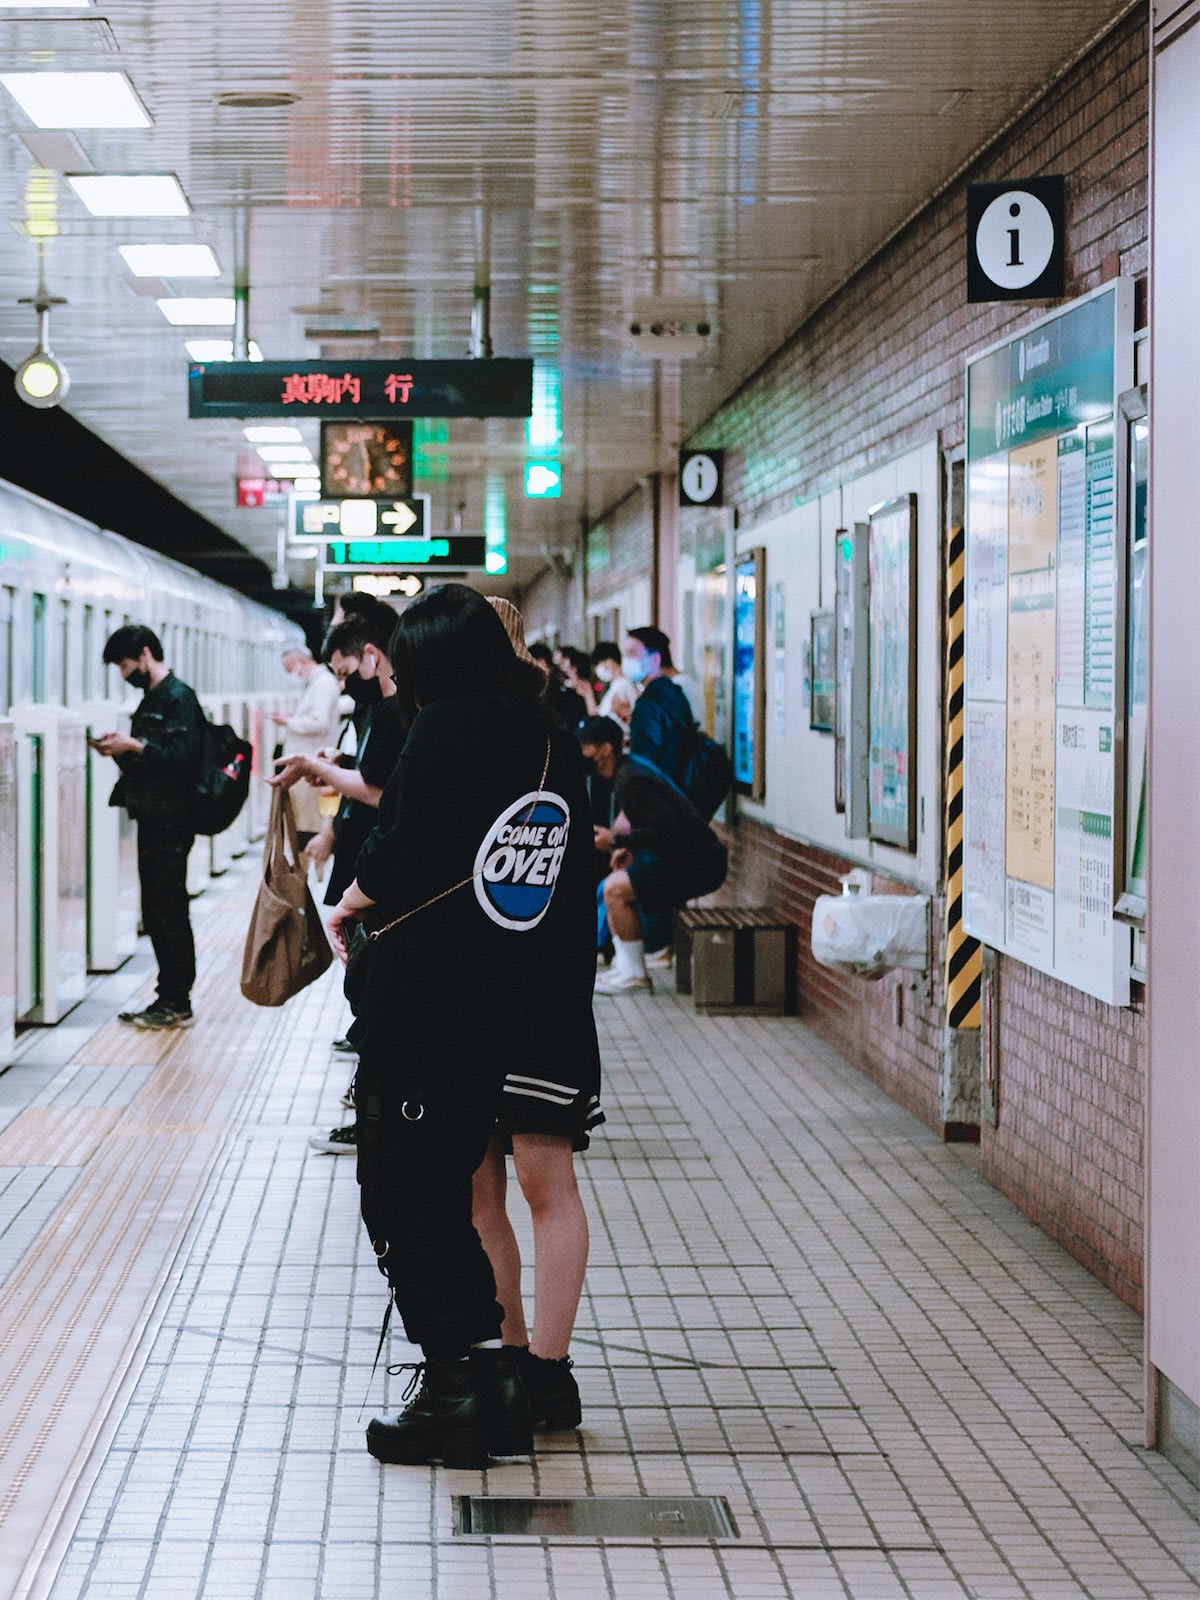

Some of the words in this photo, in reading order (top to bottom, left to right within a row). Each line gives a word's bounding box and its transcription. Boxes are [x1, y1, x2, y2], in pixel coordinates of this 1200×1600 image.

[1006, 202, 1025, 266] i
[281, 373, 361, 404] 真駒内
[384, 373, 414, 404] 行
[497, 824, 547, 846] COME
[483, 845, 566, 886] OVER
